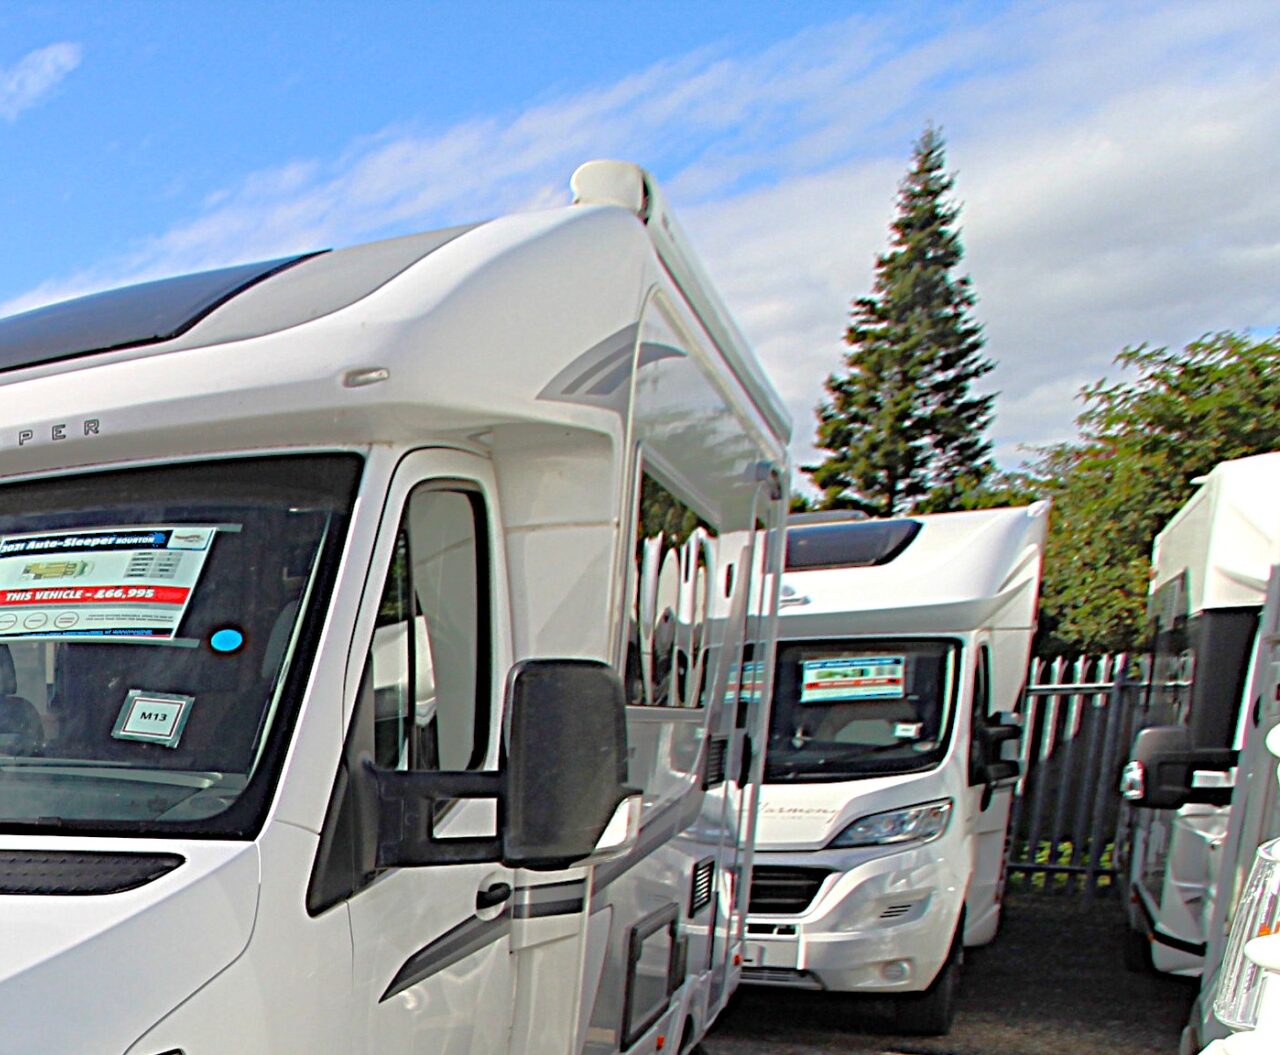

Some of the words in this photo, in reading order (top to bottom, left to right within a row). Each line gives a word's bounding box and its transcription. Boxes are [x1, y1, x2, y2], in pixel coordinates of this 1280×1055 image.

[1, 541, 25, 554] 2021
[26, 536, 116, 551] Auto-Sleeper
[116, 536, 155, 546] BOURTON
[6, 591, 34, 602] THIS
[35, 589, 83, 601] VEHICLE
[94, 588, 155, 600] £66,995
[140, 711, 168, 722] M13
